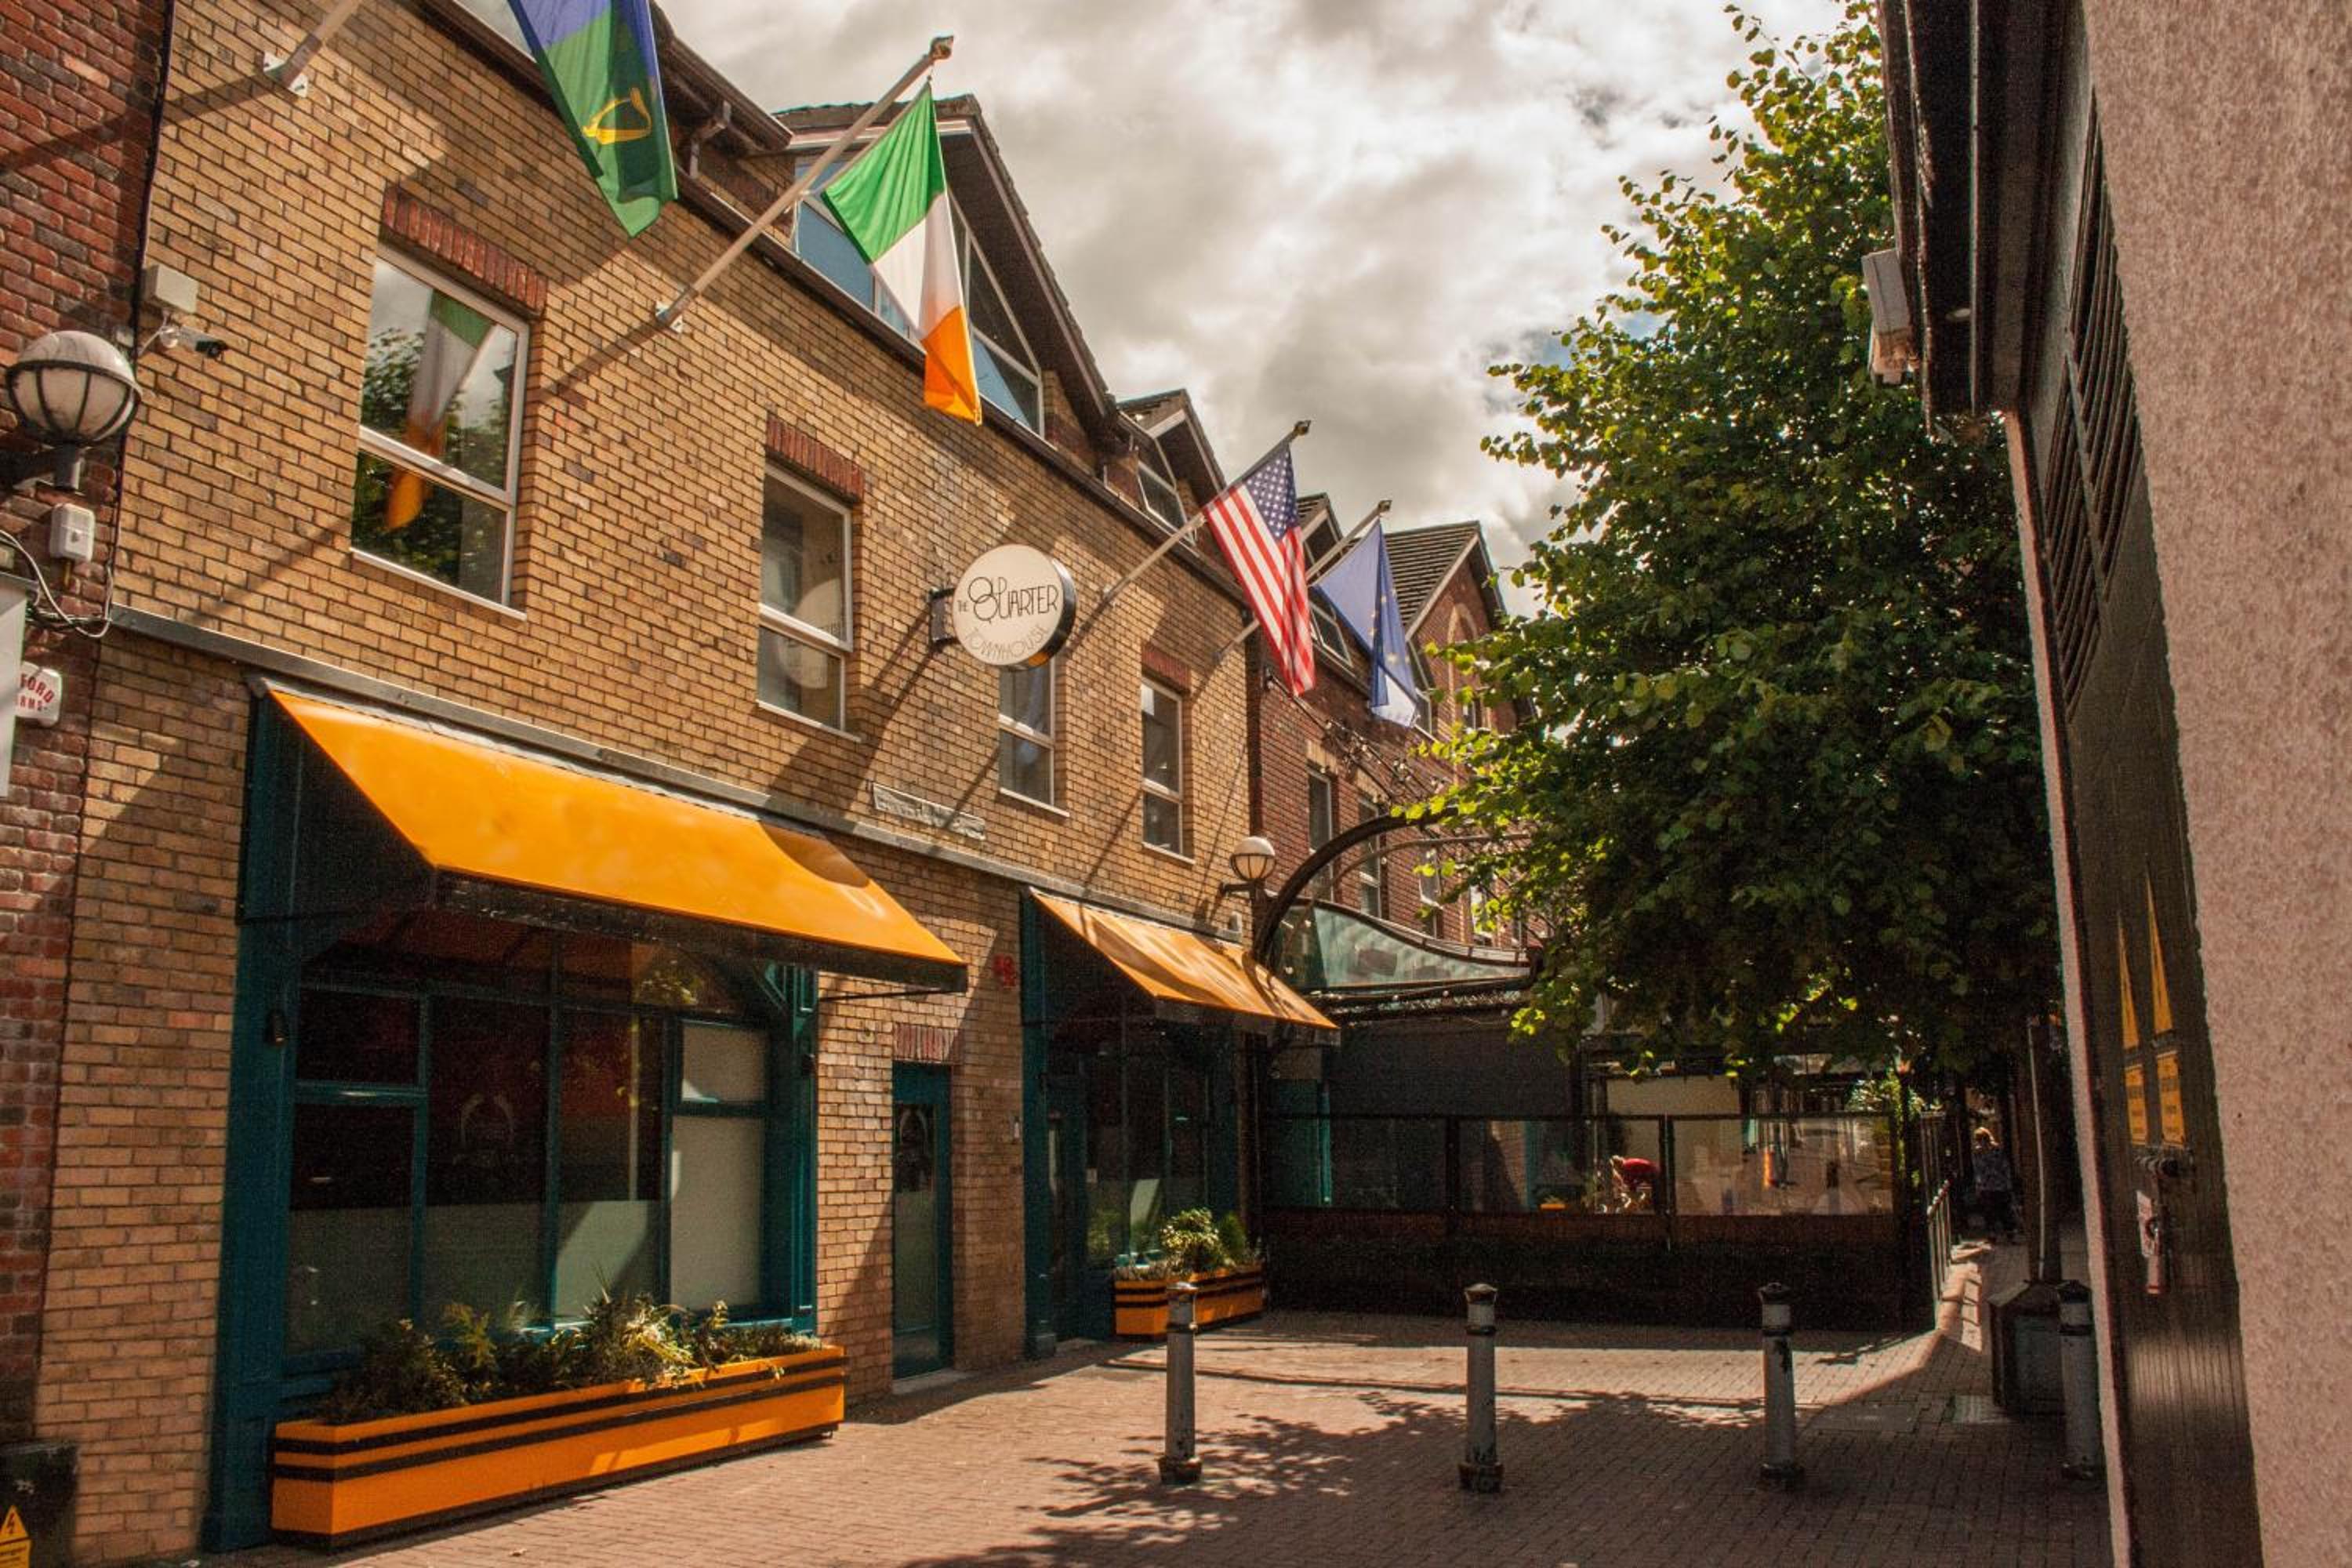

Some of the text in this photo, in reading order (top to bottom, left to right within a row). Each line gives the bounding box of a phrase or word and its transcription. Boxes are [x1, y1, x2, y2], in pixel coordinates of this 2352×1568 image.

[957, 576, 1007, 612] THE OLD
[973, 584, 1059, 624] QUARTER
[20, 673, 55, 703] FORD
